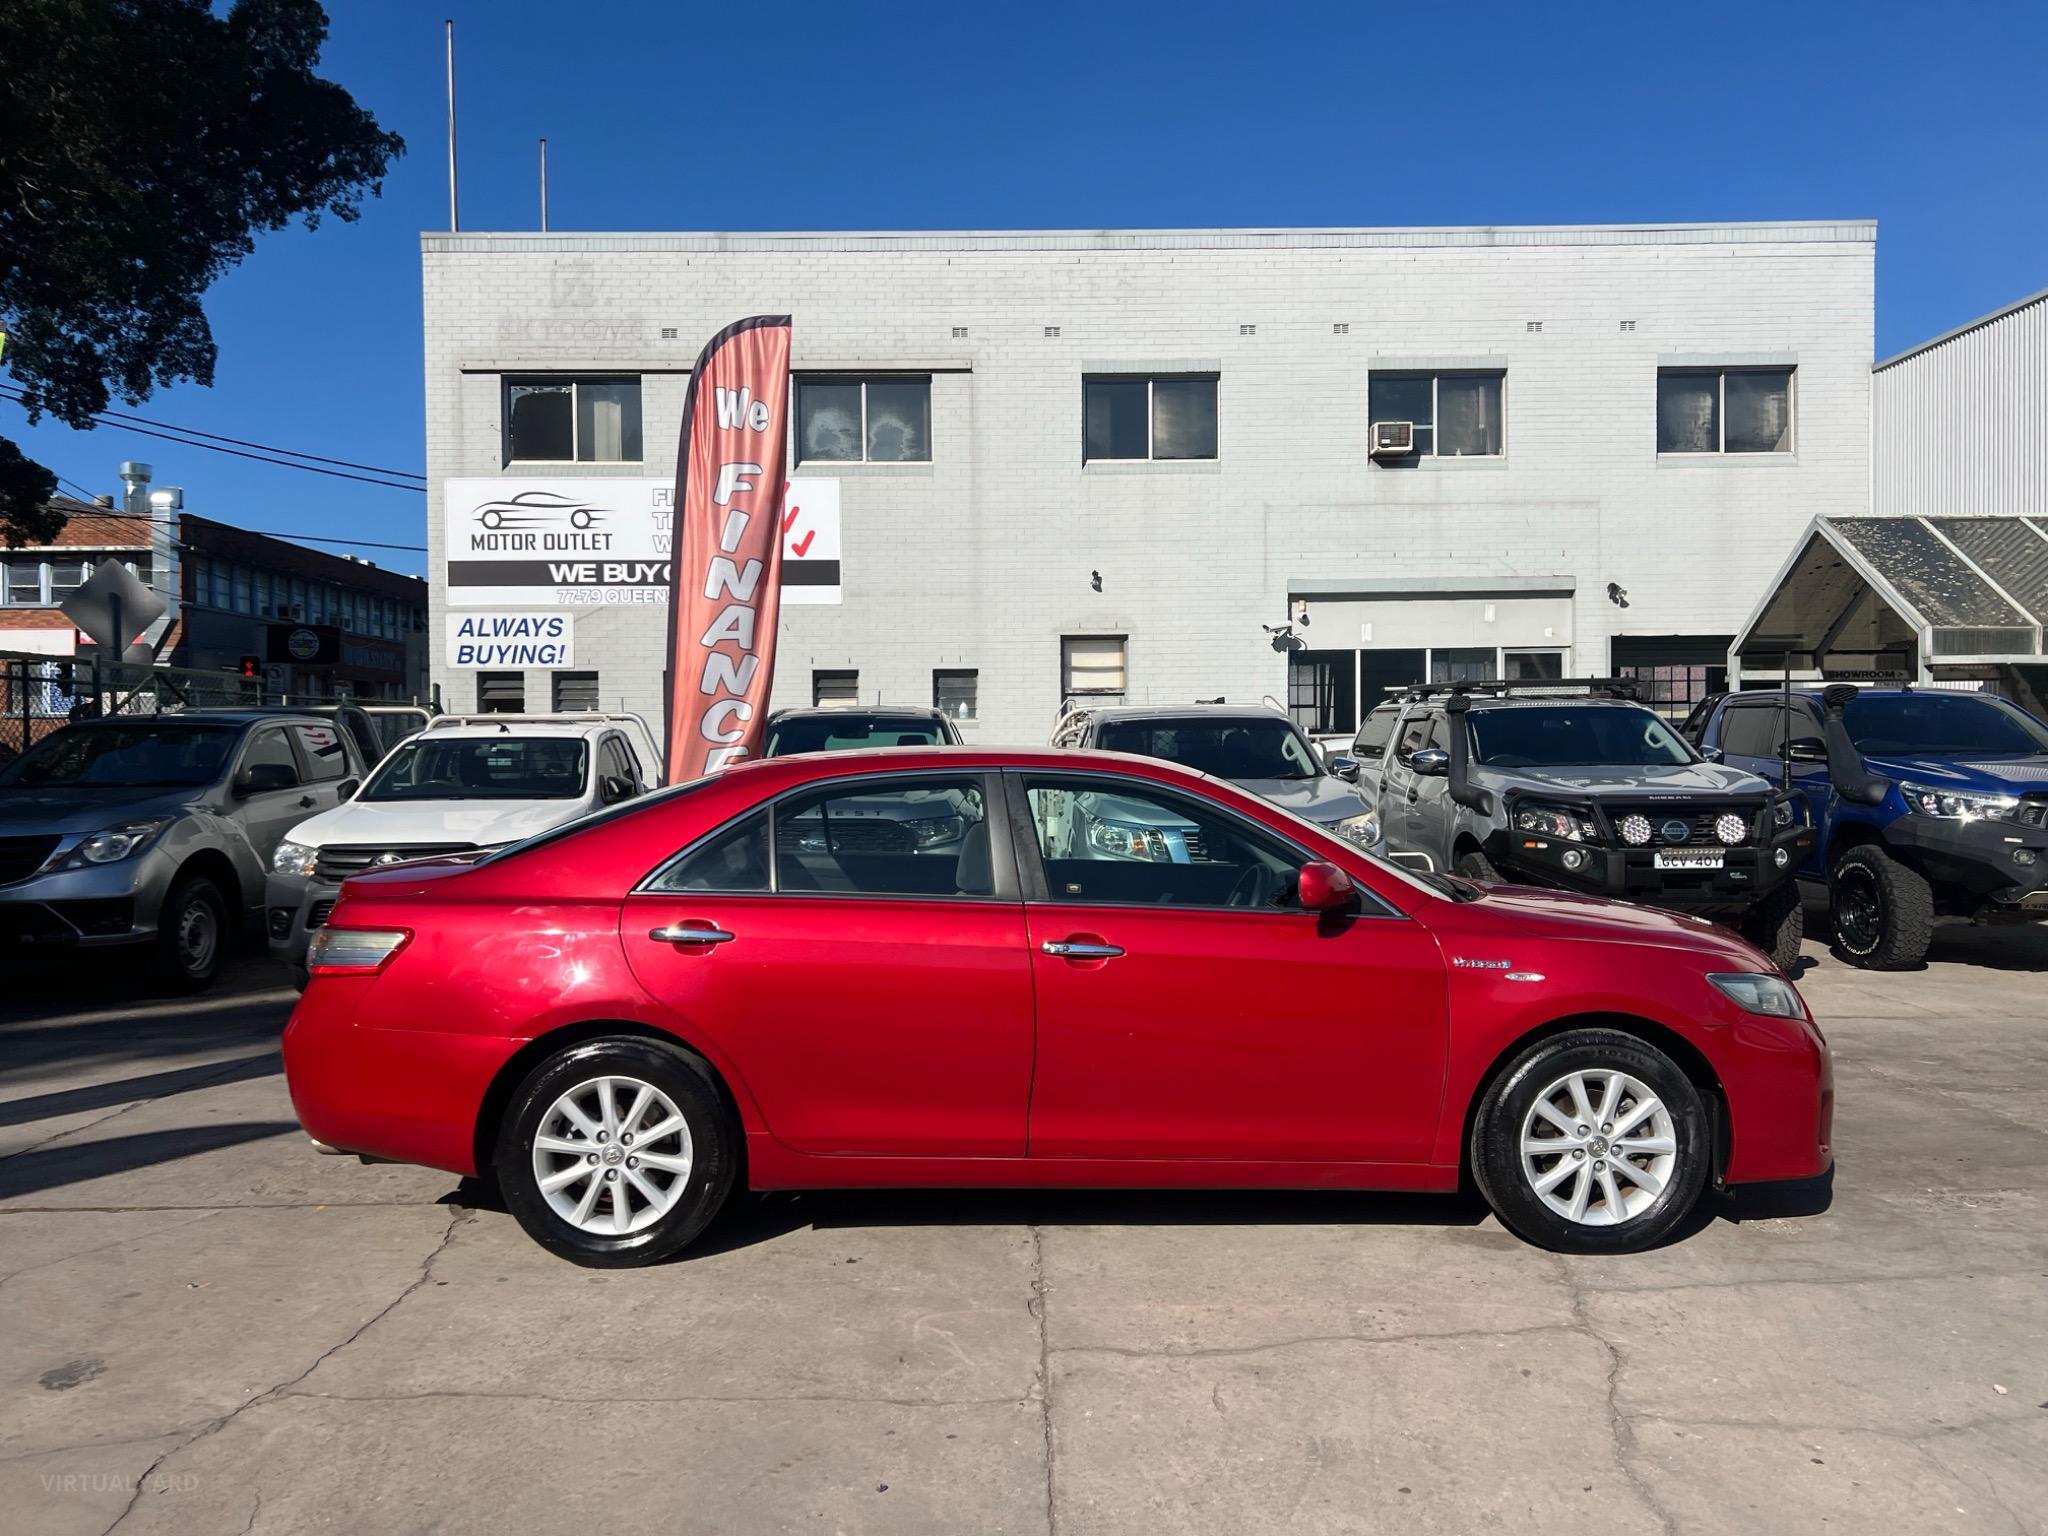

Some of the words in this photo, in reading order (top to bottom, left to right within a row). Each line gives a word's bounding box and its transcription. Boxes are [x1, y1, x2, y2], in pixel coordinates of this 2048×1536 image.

[715, 386, 769, 433] We
[471, 533, 537, 551] MOTOR
[543, 533, 613, 551] OUTLET
[548, 563, 597, 583] WE
[603, 563, 662, 583] BUY
[556, 588, 603, 604] 77-79
[605, 588, 669, 604] QUEEN
[457, 618, 564, 638] ALWAYS
[456, 645, 565, 665] BUYING!
